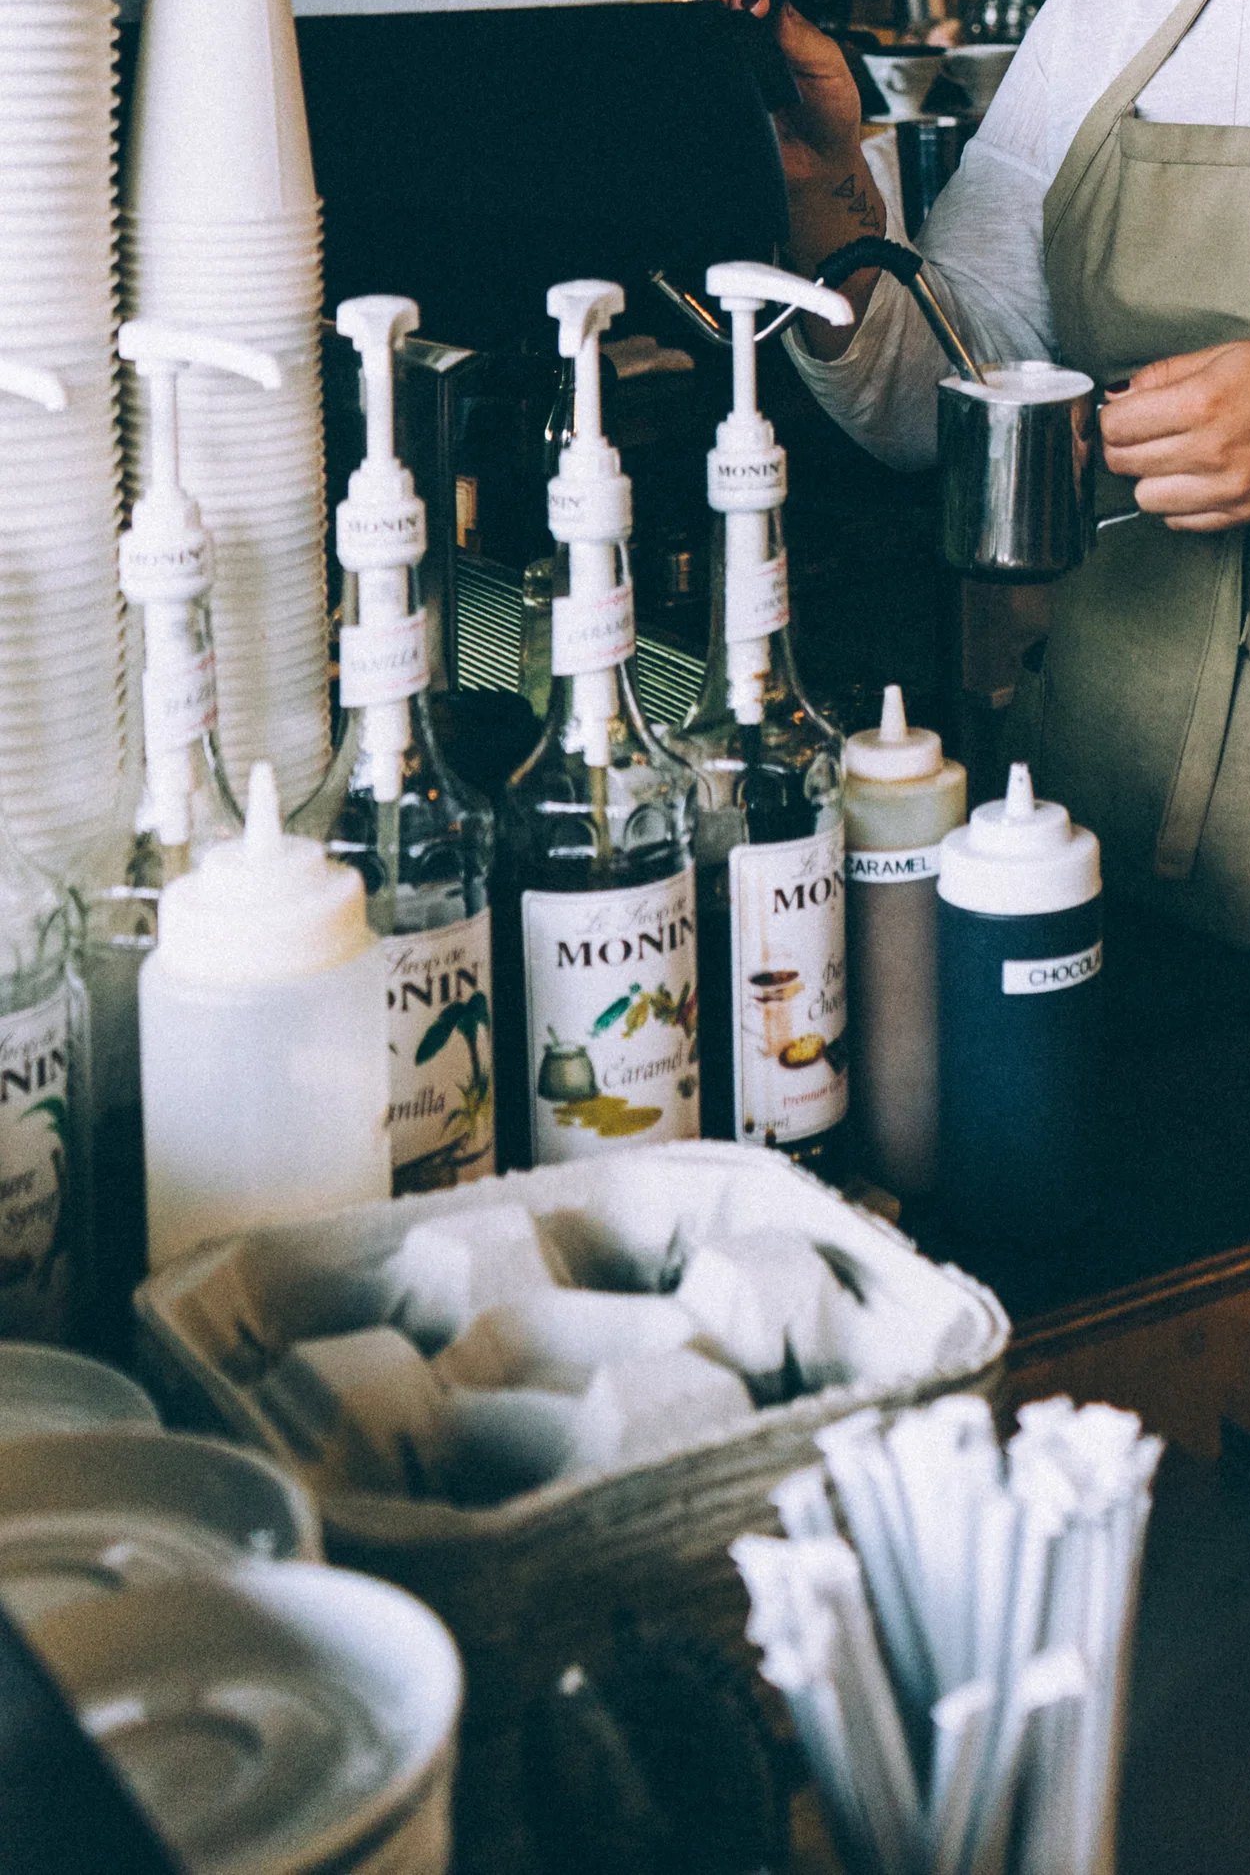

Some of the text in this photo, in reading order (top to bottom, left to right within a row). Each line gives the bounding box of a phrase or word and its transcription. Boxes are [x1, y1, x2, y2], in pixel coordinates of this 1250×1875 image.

[717, 461, 780, 479] MONIN
[773, 870, 845, 914] MON
[557, 915, 694, 968] MONIN
[387, 961, 479, 1013] NIN
[0, 1047, 66, 1102] NIN
[602, 1040, 684, 1089] Caramel
